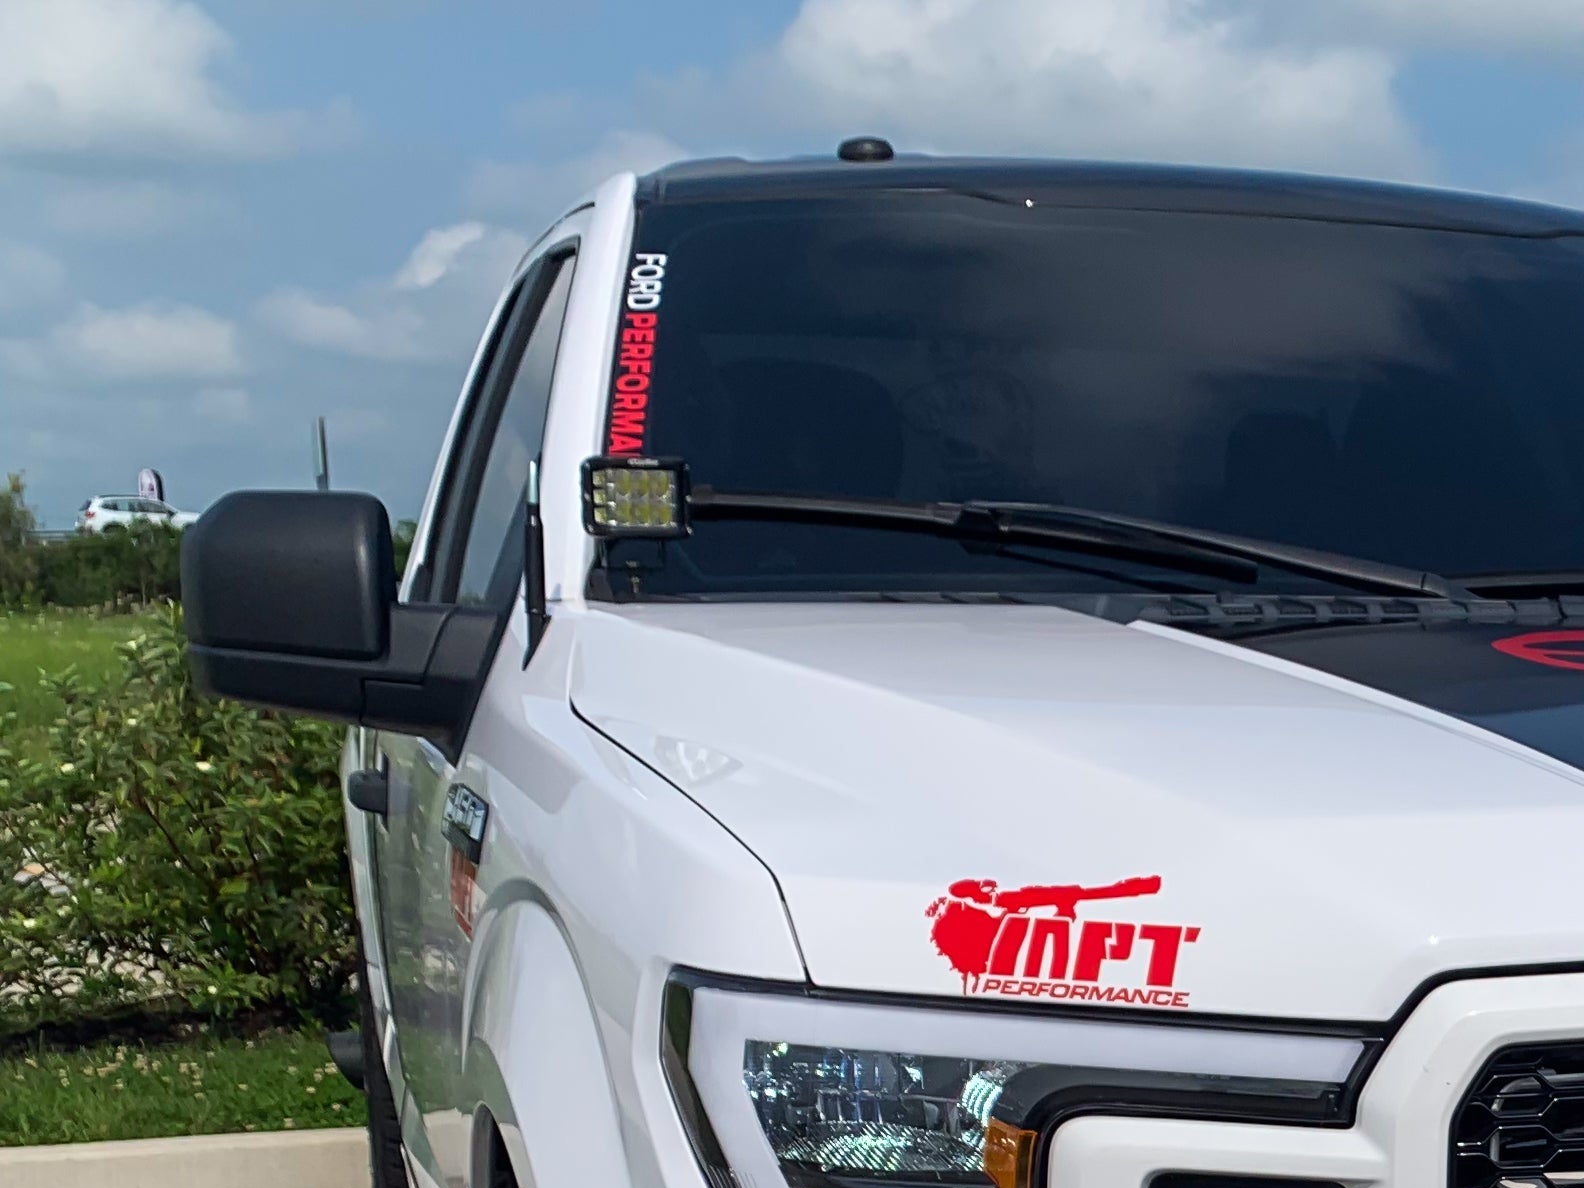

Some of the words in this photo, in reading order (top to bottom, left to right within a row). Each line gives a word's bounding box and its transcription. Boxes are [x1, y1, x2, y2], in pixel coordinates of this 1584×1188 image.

[626, 253, 667, 310] FORD
[607, 312, 658, 456] PERFORMA
[982, 979, 1190, 1008] PERFORMANCE
